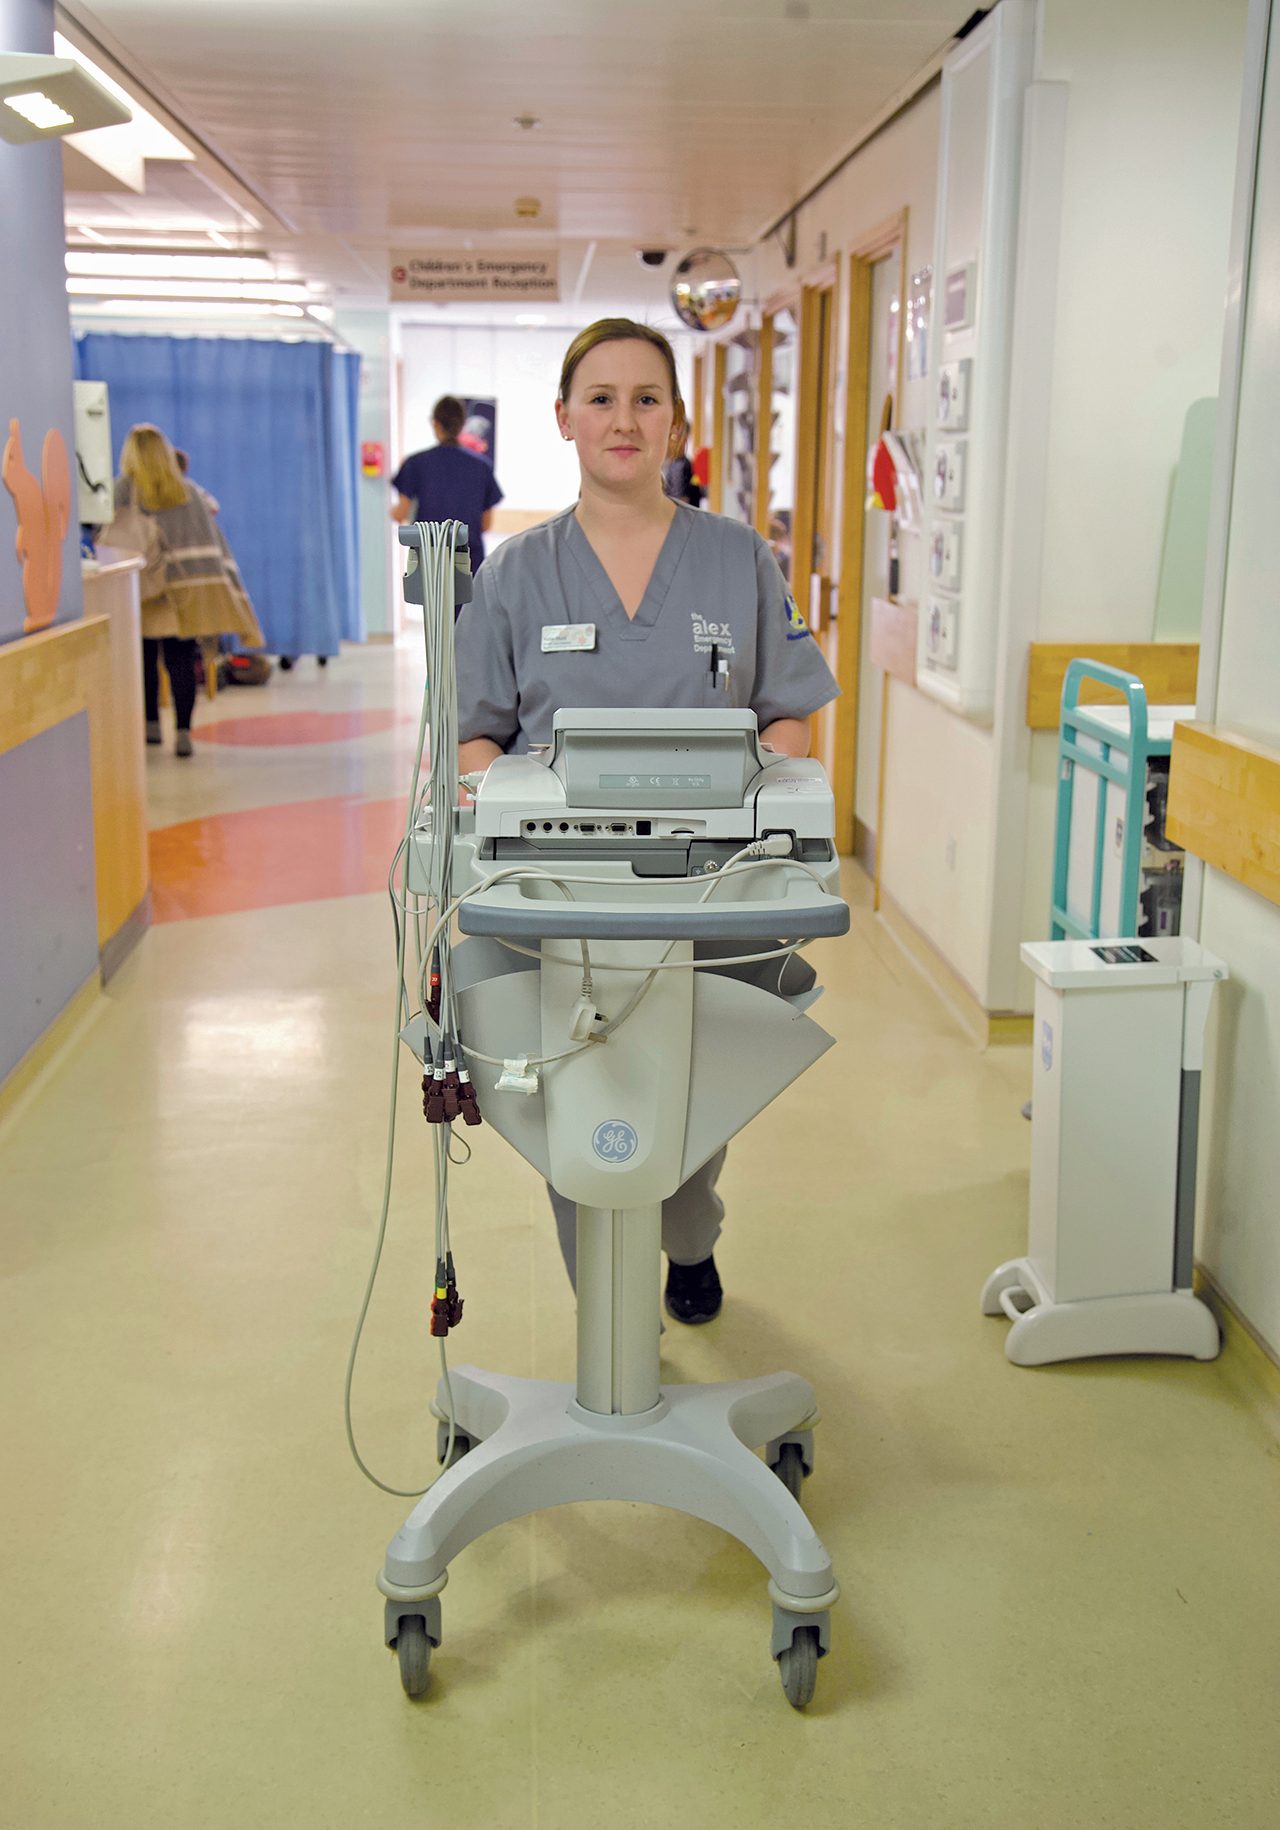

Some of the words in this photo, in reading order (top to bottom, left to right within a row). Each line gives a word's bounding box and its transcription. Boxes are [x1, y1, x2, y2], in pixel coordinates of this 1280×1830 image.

[476, 260, 547, 275] Emergency
[409, 276, 488, 290] Department
[491, 276, 558, 290] Reception
[692, 620, 732, 637] alex
[693, 634, 732, 647] Emergency
